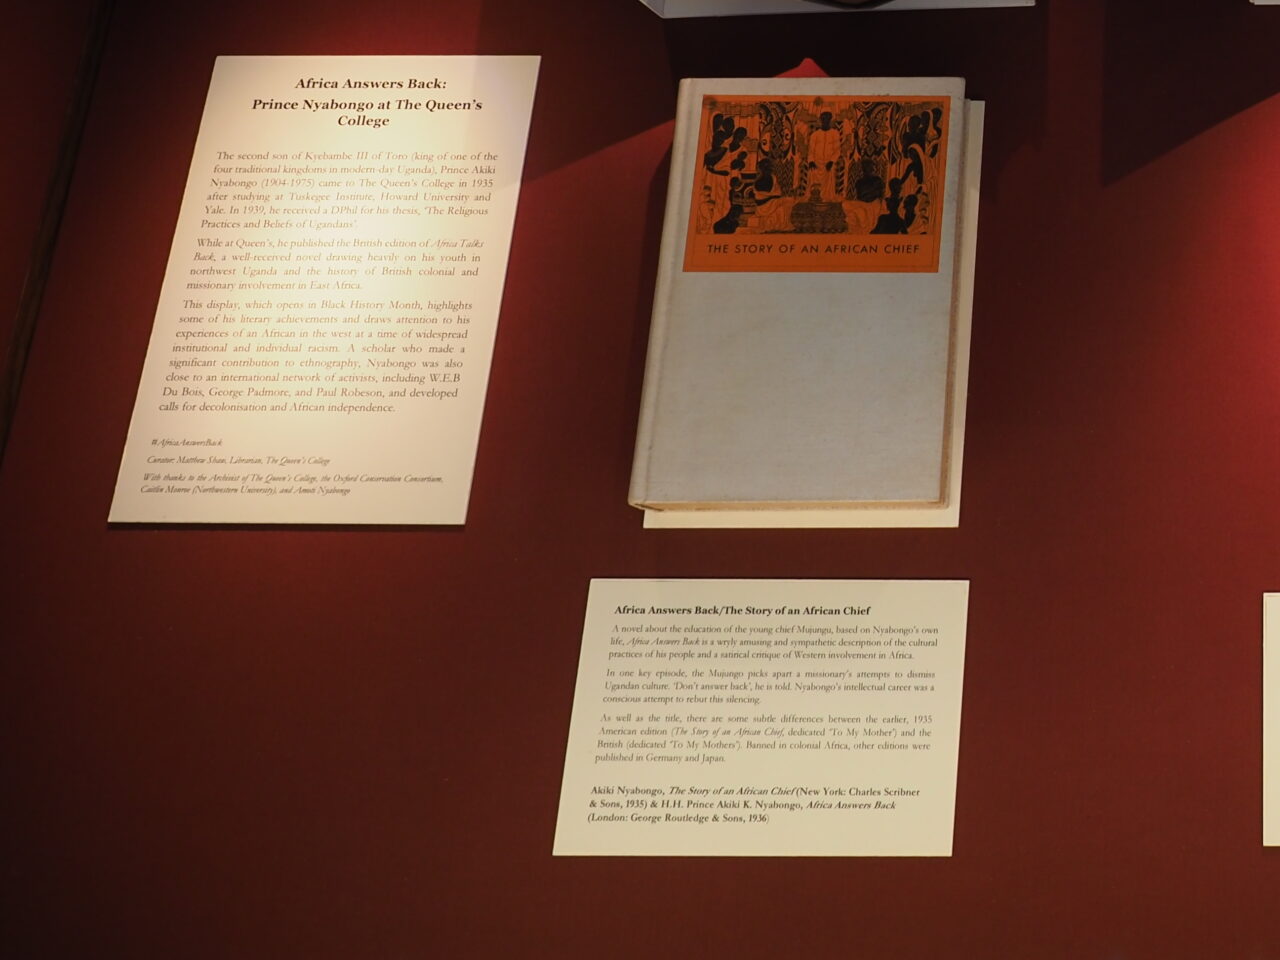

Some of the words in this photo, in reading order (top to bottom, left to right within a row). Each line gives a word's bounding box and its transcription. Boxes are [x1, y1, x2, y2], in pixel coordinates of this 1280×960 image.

[294, 77, 339, 89] Africa
[342, 78, 404, 89] Answers
[407, 77, 447, 89] Back:
[252, 98, 299, 110] Prince
[302, 99, 374, 113] Nyabongo
[377, 100, 391, 110] at
[396, 98, 422, 110] The
[425, 99, 483, 112] Queen's
[337, 114, 390, 128] College
[708, 244, 729, 254] THE
[735, 244, 773, 254] STORY
[778, 244, 795, 254] OF
[801, 244, 819, 254] AN
[825, 244, 879, 254] AFRICAN
[883, 244, 920, 255] CHIEF
[162, 386, 178, 396] Du
[181, 386, 205, 397] Bois,
[208, 386, 243, 399] George
[247, 386, 291, 398] Padmore,
[294, 387, 312, 397] and
[316, 387, 337, 397] Paul
[340, 387, 385, 398] Robeson,
[388, 387, 406, 397] and
[409, 387, 458, 400] developed
[159, 401, 179, 411] calls
[182, 401, 197, 411] for
[269, 402, 287, 412] and
[289, 402, 325, 412] African
[327, 402, 395, 415] independence.
[613, 605, 646, 615] Africa
[647, 605, 693, 615] Answers
[693, 605, 744, 617] Back/The
[745, 605, 774, 617] Story
[774, 605, 787, 616] of
[787, 607, 801, 616] an
[803, 606, 841, 616] African
[843, 606, 872, 616] Chief
[590, 785, 615, 795] Akiki
[617, 786, 666, 798] Nyabongo,
[668, 786, 687, 795] The
[687, 786, 711, 798] Story
[712, 786, 724, 796] of
[722, 788, 735, 796] an
[735, 786, 769, 796] African
[770, 786, 795, 796] Chief
[795, 787, 821, 798] (New
[823, 787, 847, 797] York:
[848, 787, 882, 797] Charles
[883, 787, 921, 797] Scribner
[587, 813, 629, 824] (London:
[630, 813, 662, 825] George
[664, 813, 710, 825] Routledge
[711, 813, 720, 823] &
[722, 813, 746, 824] Sons,
[748, 813, 770, 824] 1936)
